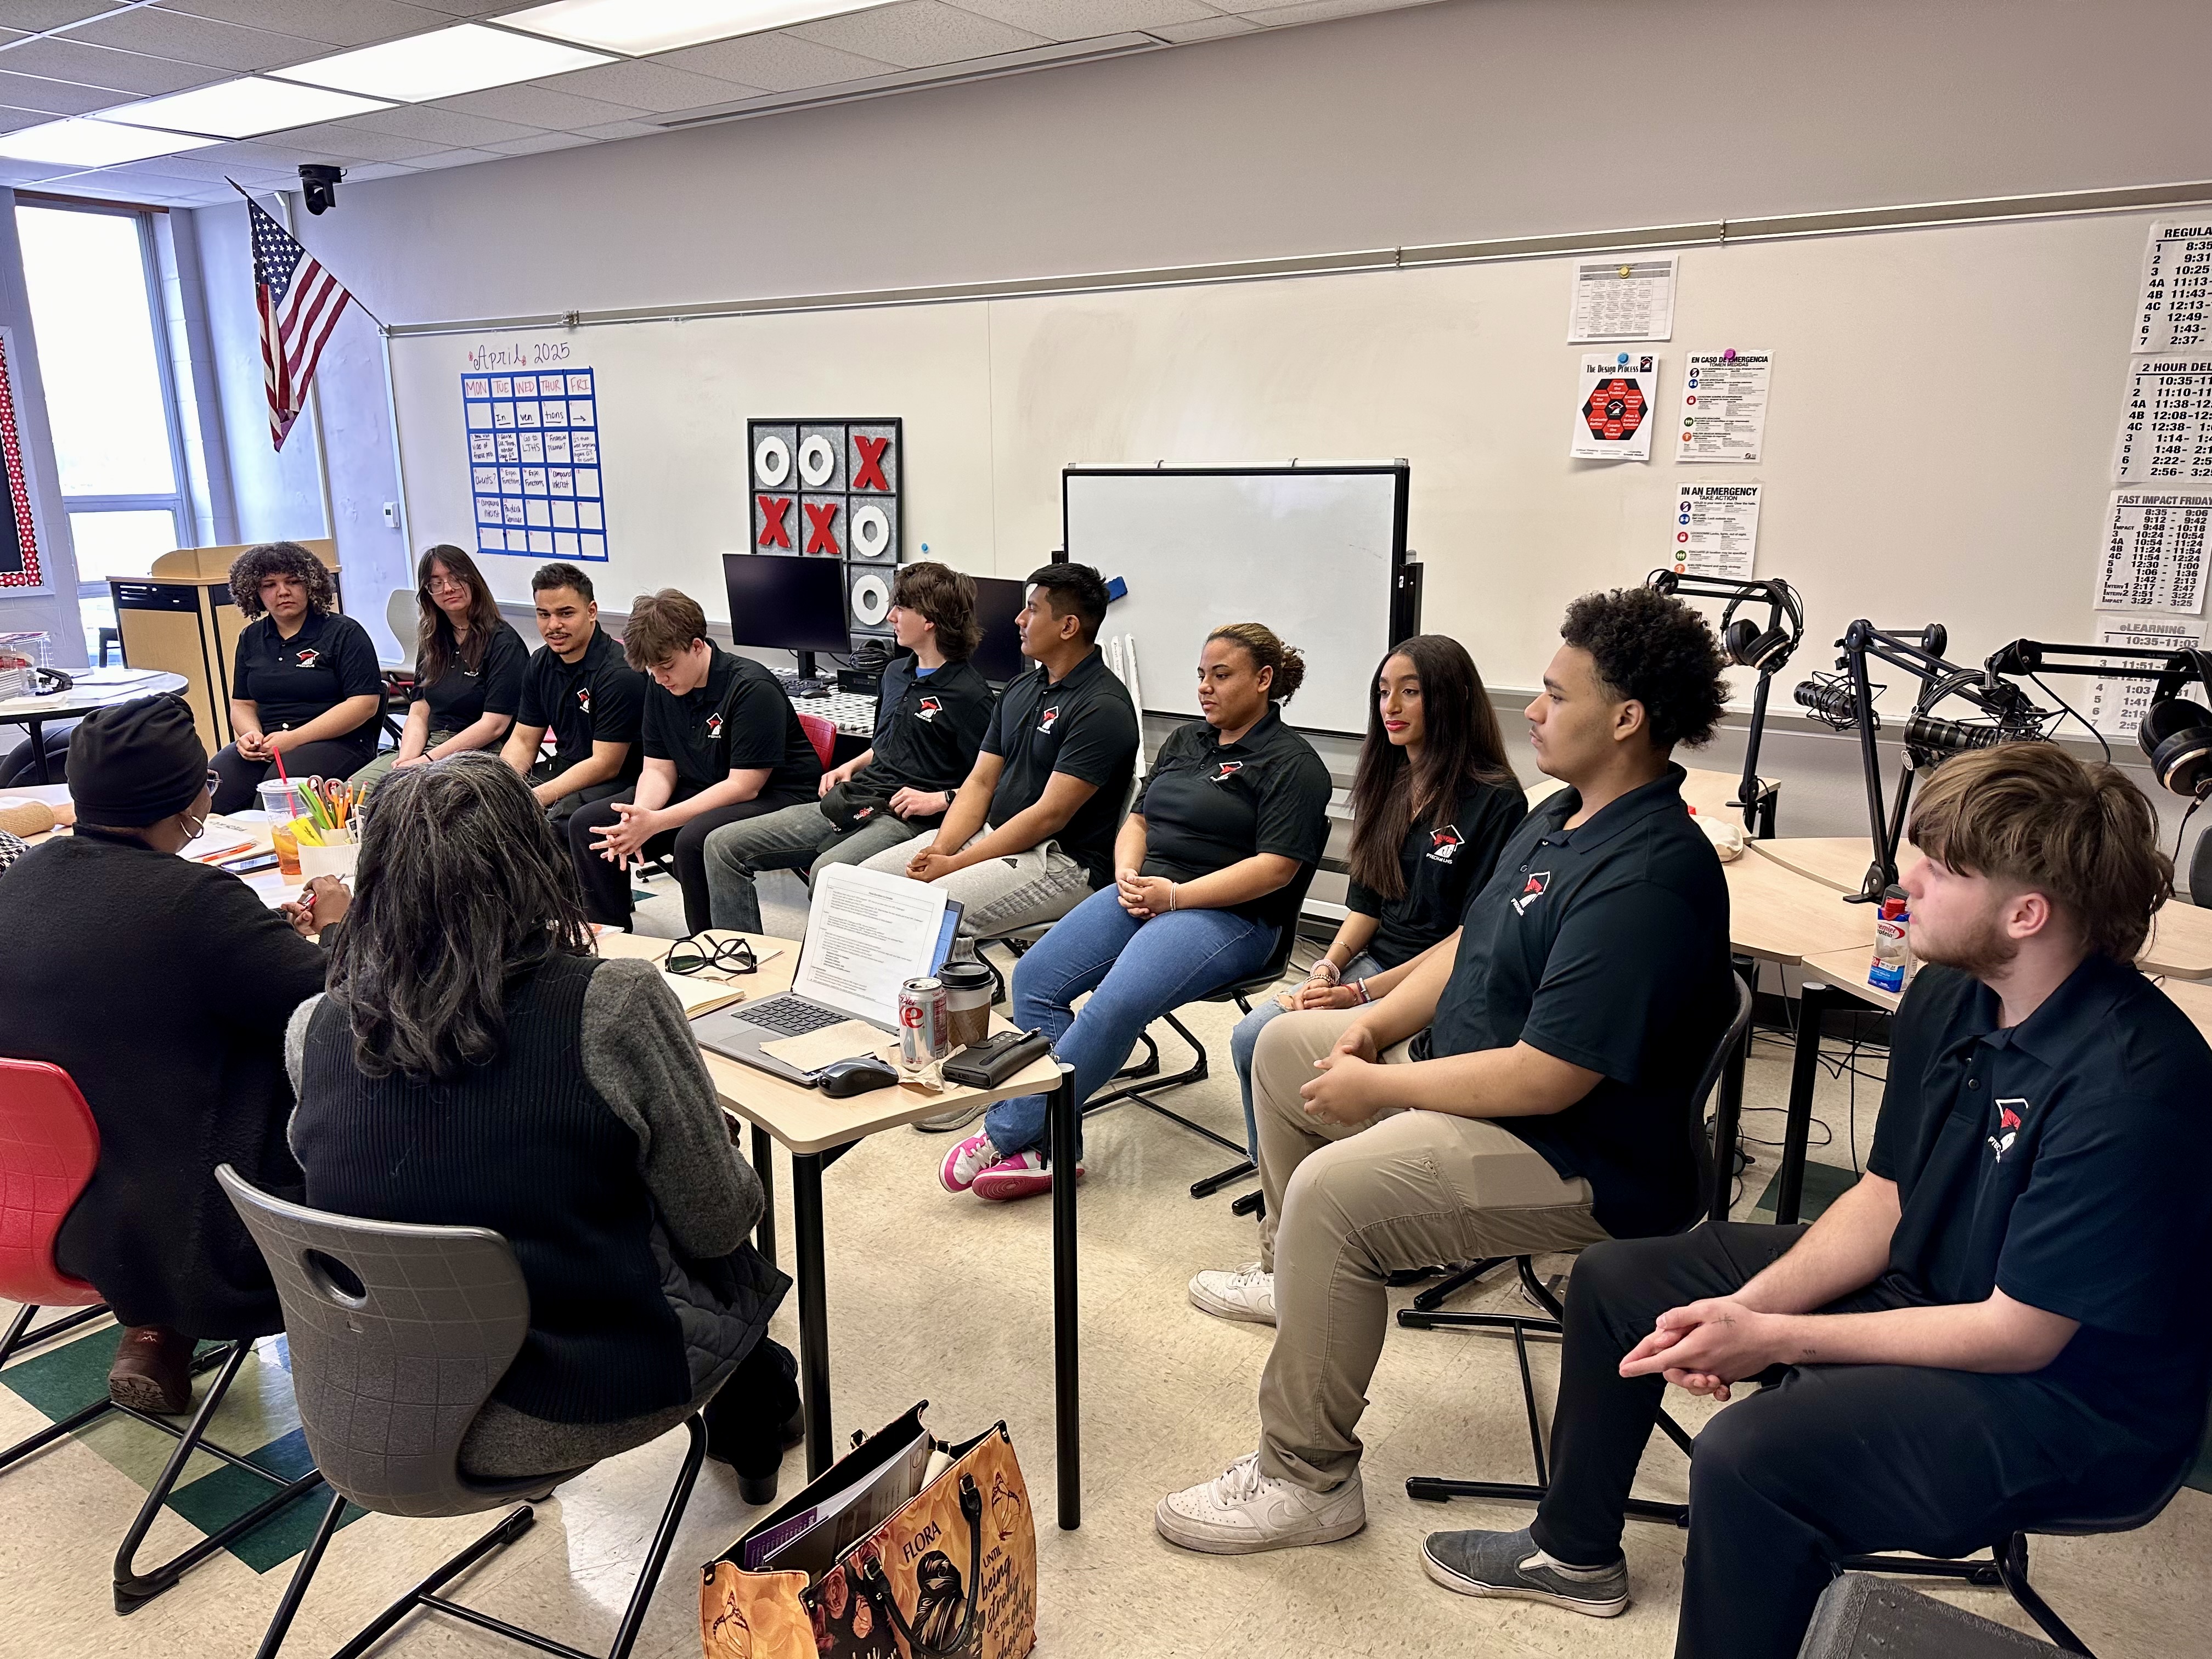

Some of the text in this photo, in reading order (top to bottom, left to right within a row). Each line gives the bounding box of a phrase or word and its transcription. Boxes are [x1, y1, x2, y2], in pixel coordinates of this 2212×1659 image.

[2156, 244, 2161, 252] 1
[2153, 256, 2160, 264] 2
[2176, 265, 2210, 274] 10:25
[2149, 279, 2164, 287] 4A
[2145, 301, 2212, 311] 4C 12:13-
[2143, 313, 2208, 322] 5 12:49-
[2174, 324, 2206, 333] 1:43-
[2170, 336, 2204, 345] 2:37-
[473, 342, 569, 370] April 2025
[1598, 365, 1616, 374] Design
[1618, 364, 1638, 373] Process
[2154, 363, 2187, 371] HOUR
[2136, 377, 2141, 385] 1
[466, 381, 487, 396] MON
[494, 380, 509, 393] TUE
[516, 381, 534, 393] WED
[540, 380, 561, 393] THUR
[545, 411, 564, 420] tions
[2128, 422, 2142, 431] 4C
[2157, 434, 2189, 442] 1:14-
[755, 434, 889, 490] O O X
[2117, 495, 2212, 505] FAST IMPACT FRIDAY
[758, 495, 889, 557] X X O
[851, 574, 889, 625] O
[2119, 623, 2186, 635] eLEARNING
[2126, 636, 2198, 648] 10:35-11:03
[2124, 698, 2152, 706] 1:41
[2090, 719, 2098, 727] 7
[902, 1520, 942, 1563] FLORA
[983, 1545, 1002, 1568] UNTIL
[981, 1555, 1012, 1601] being
[987, 1573, 1020, 1633] strong
[994, 1583, 1031, 1640] IS THE only
